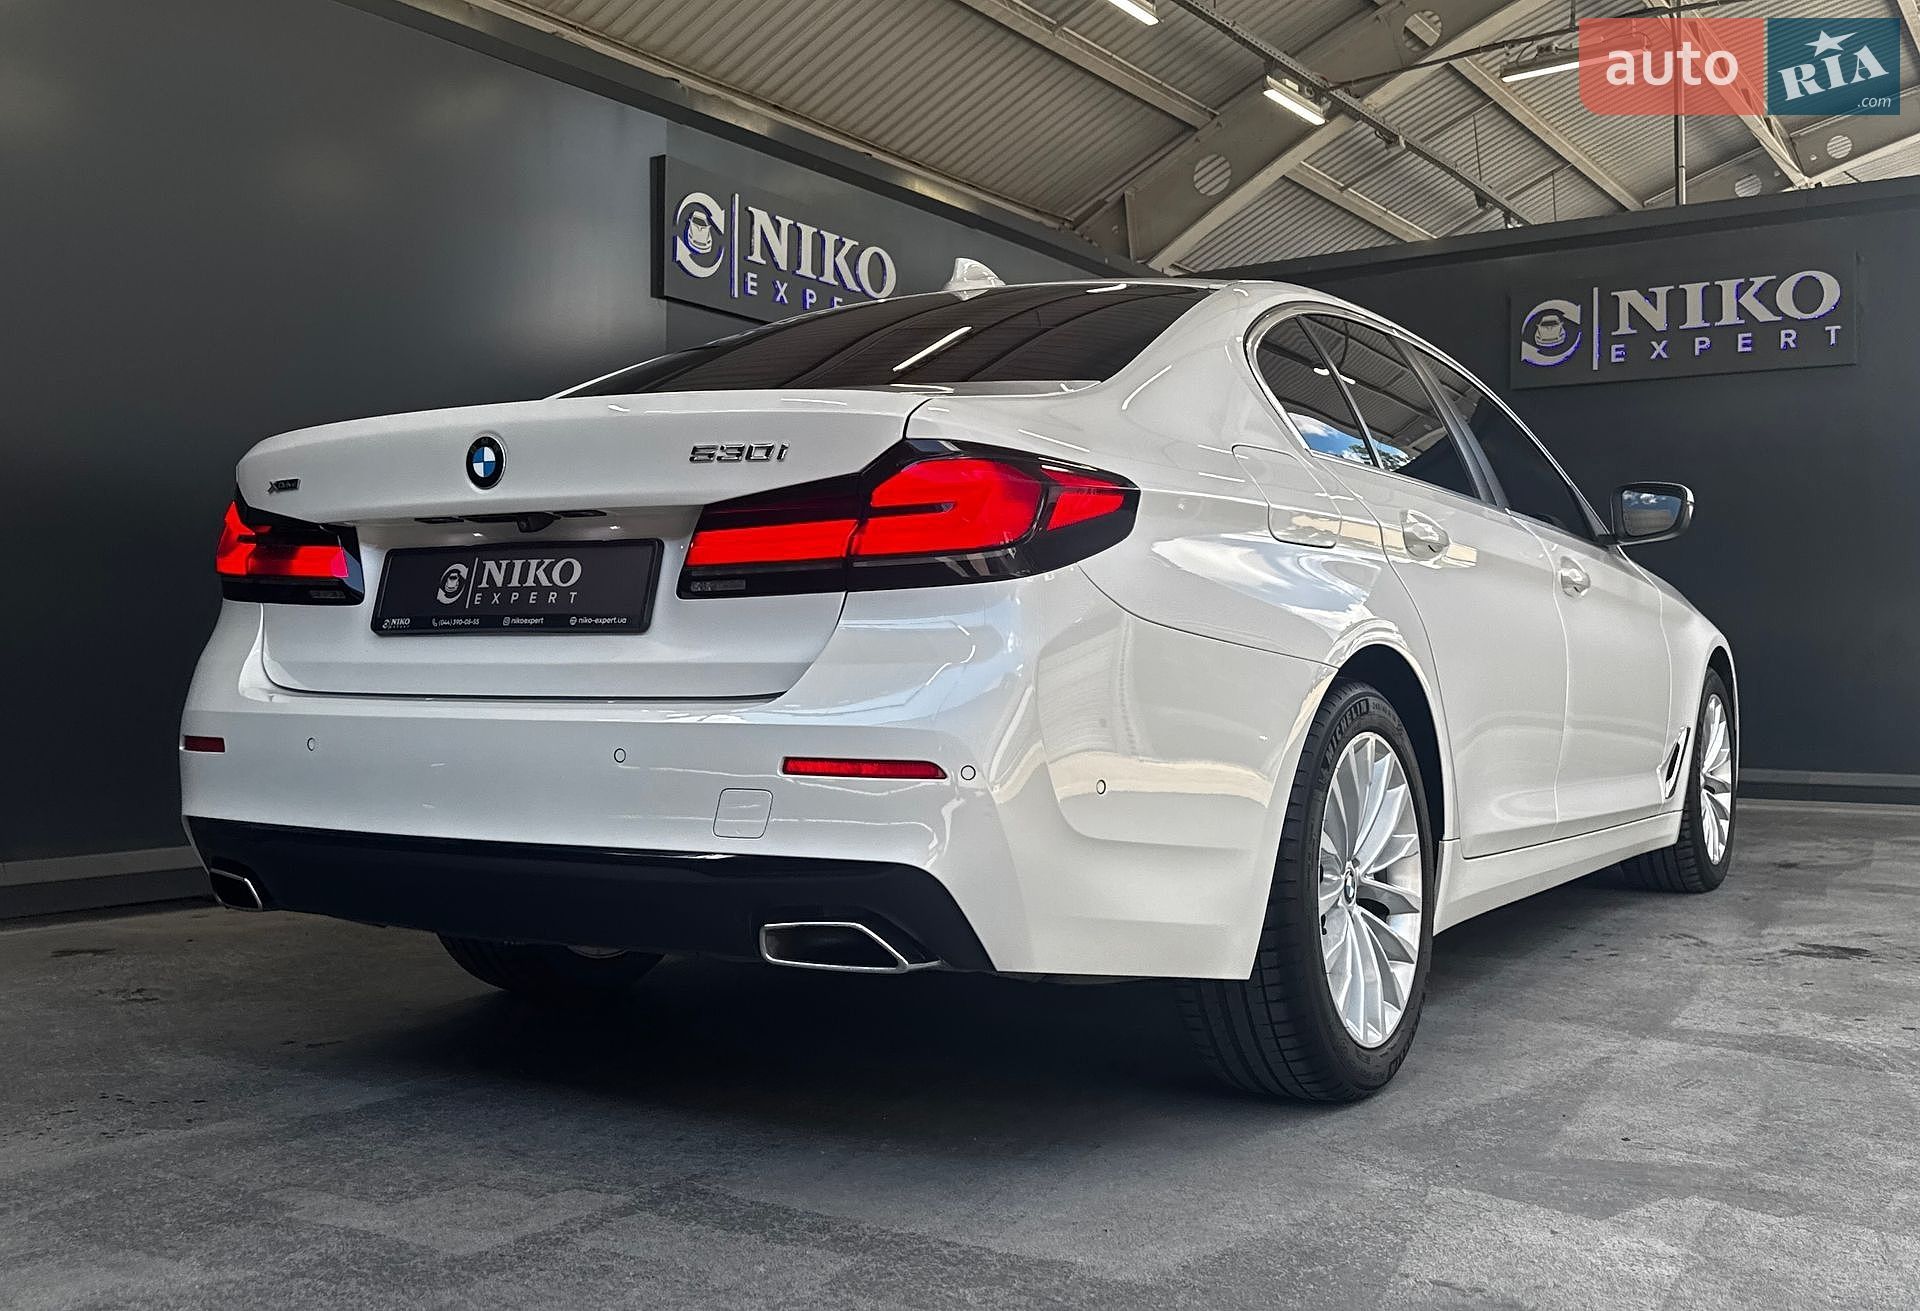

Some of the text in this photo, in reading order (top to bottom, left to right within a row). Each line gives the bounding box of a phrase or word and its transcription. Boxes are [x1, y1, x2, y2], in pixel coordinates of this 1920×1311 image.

[745, 205, 897, 300] NIKO
[1610, 269, 1841, 337] NIKO
[1610, 325, 1843, 364] EXPERT
[688, 442, 790, 463] 530i
[479, 557, 583, 589] NIKO
[474, 592, 578, 605] EXPERT
